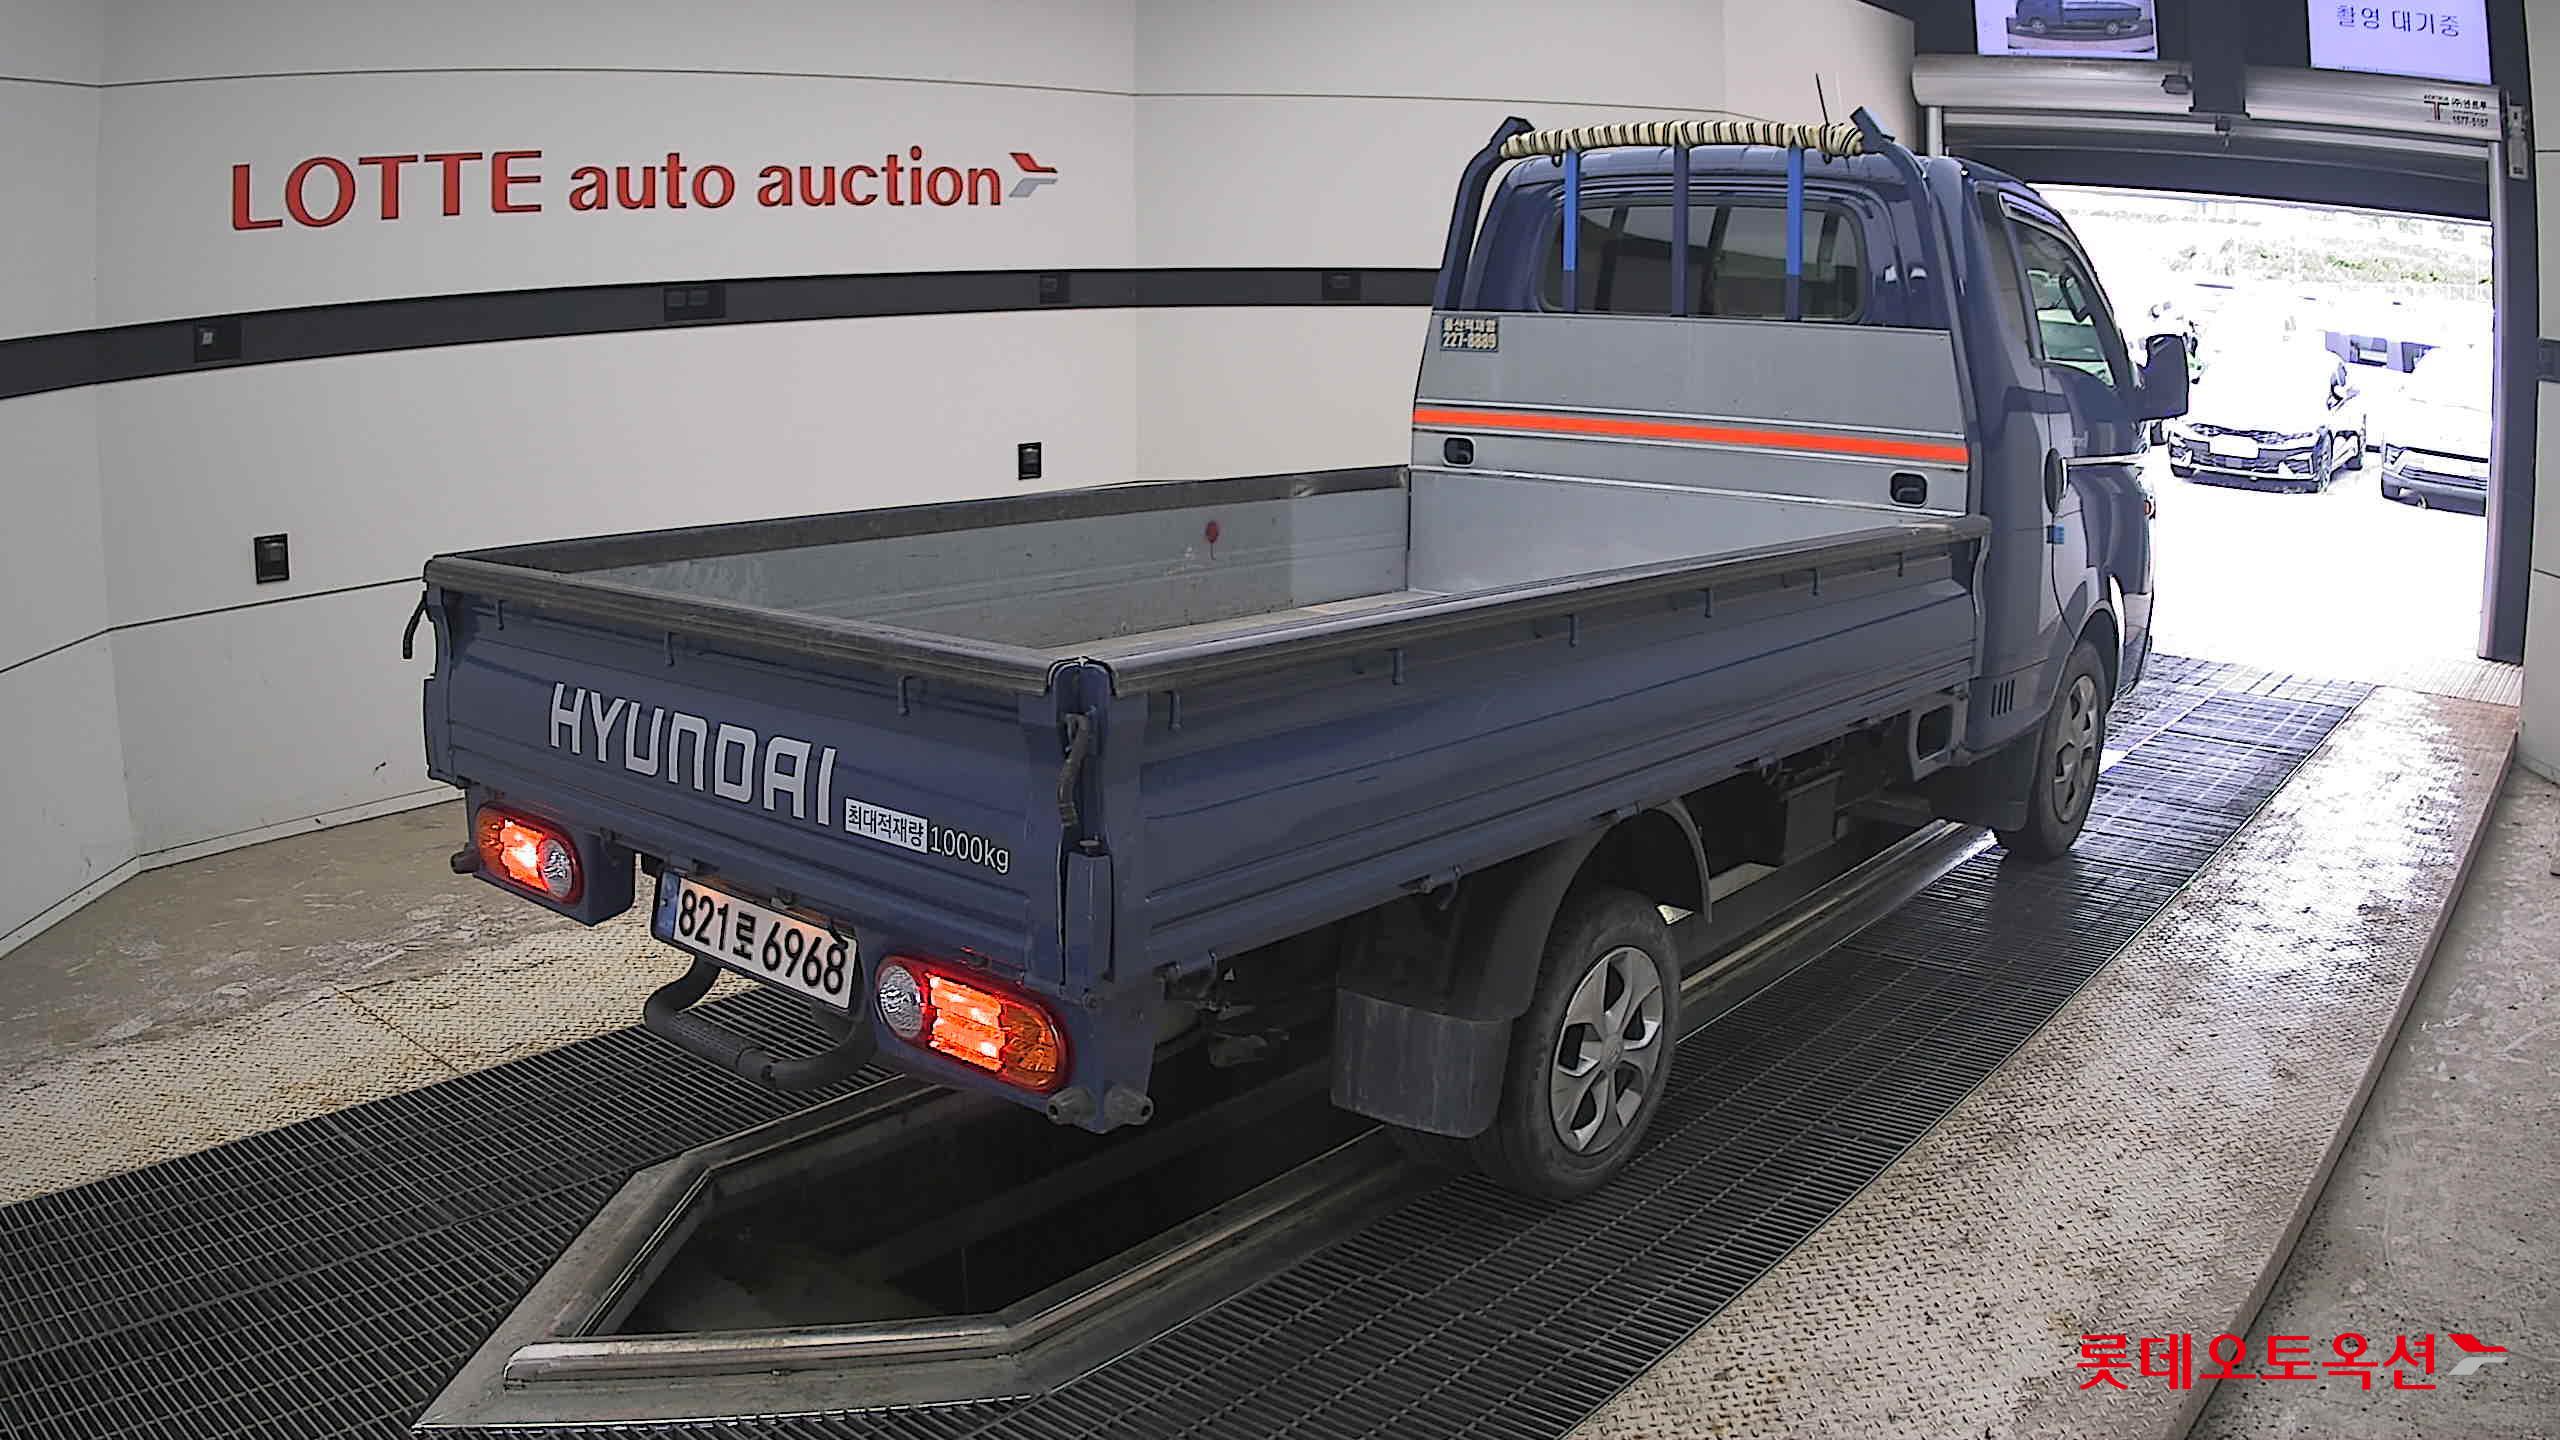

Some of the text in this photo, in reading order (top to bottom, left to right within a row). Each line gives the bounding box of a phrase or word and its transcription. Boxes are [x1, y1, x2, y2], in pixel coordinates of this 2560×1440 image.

[2337, 4, 2460, 38] 촬영 대기중
[232, 147, 1003, 231] LOTTE auto auction
[550, 682, 838, 826] HYUNDAI
[847, 804, 926, 847] 최대적재량
